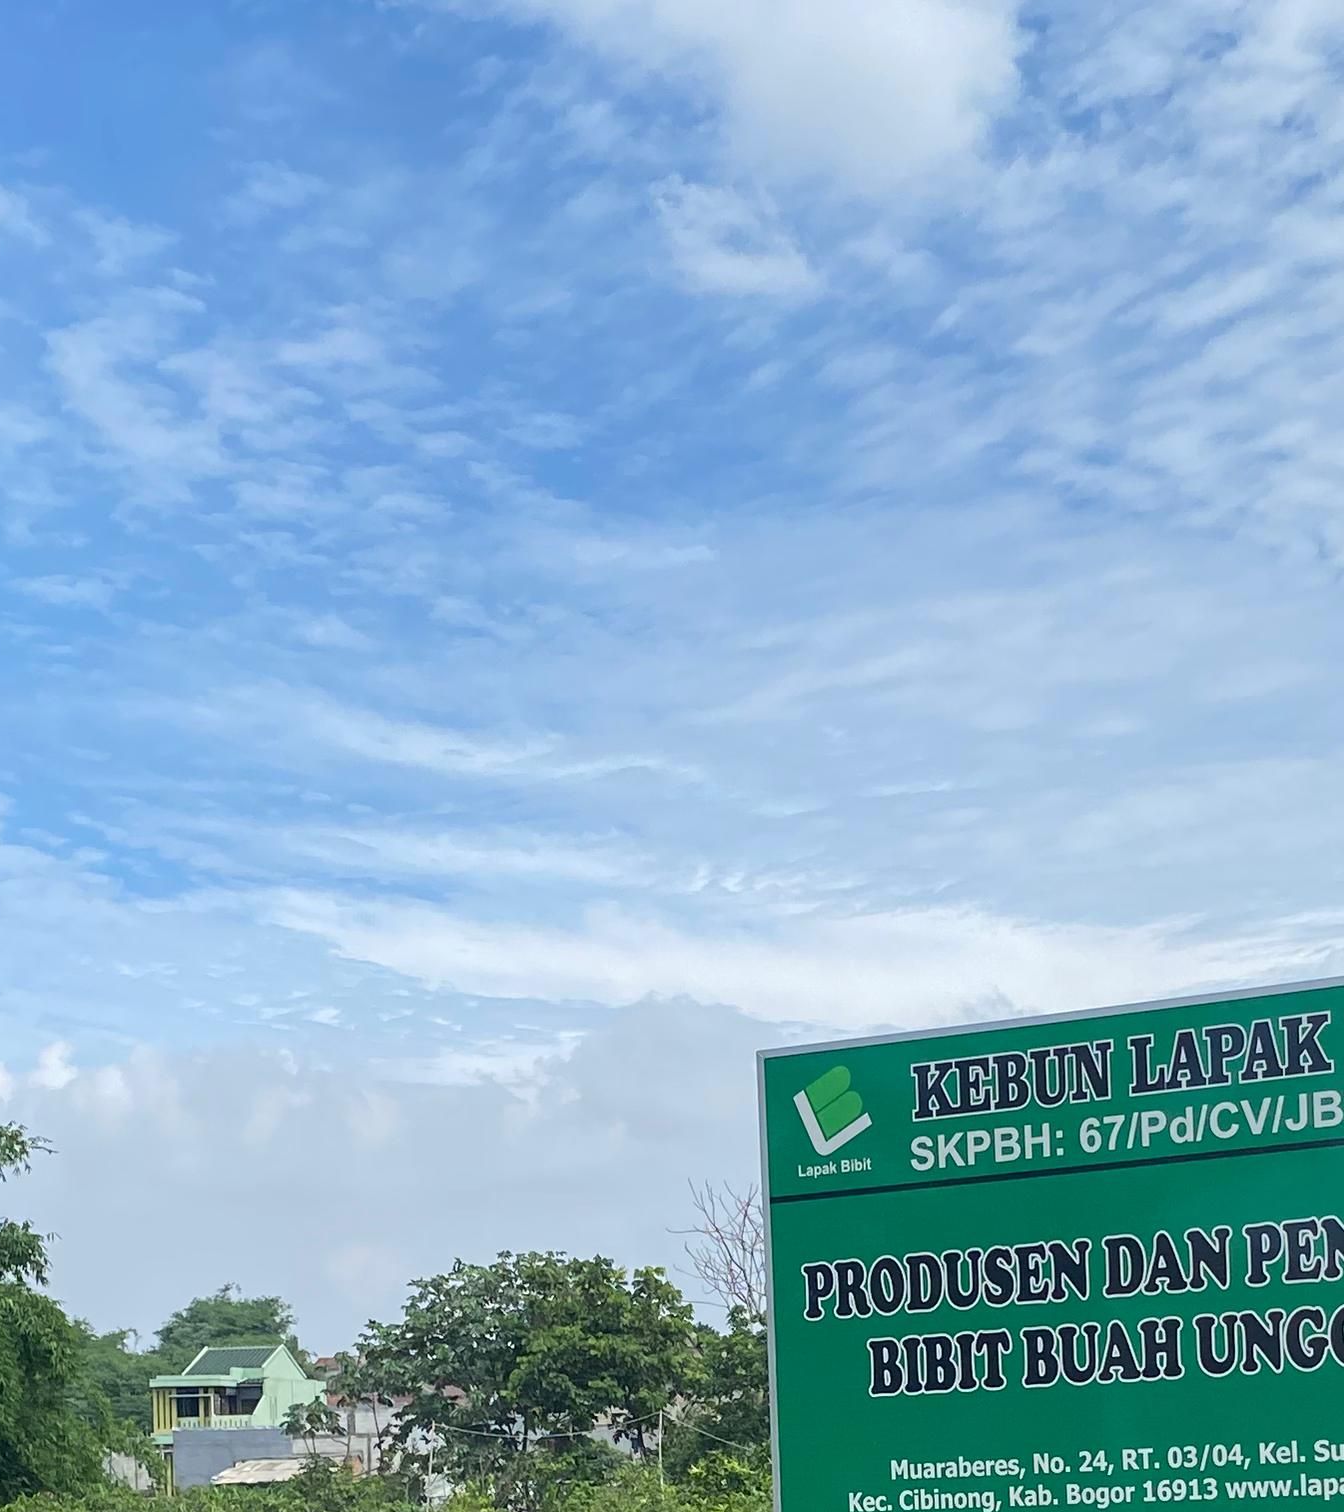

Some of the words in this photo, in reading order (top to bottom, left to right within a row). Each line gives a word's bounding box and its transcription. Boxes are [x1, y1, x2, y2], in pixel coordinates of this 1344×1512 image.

[911, 1039, 1113, 1122] KEBUN
[1128, 1009, 1334, 1097] LAPAK
[798, 1161, 837, 1179] Lapak
[841, 1157, 872, 1173] Bibit
[910, 1122, 1064, 1171] SKPBH:
[801, 1238, 1091, 1321] PRODUSEN
[1102, 1225, 1232, 1298] DAN
[867, 1328, 1012, 1397] BIBIT
[1020, 1316, 1185, 1388] BUAH
[890, 1456, 1026, 1480] Muaraberes,
[1033, 1453, 1071, 1474] No.
[1078, 1450, 1114, 1475] 24,
[1121, 1448, 1160, 1470] RT.
[1167, 1443, 1251, 1471] 03/04,
[1258, 1440, 1306, 1464] Kel.
[848, 1492, 892, 1512] Kec.
[899, 1489, 1002, 1512] Cibinong,
[1009, 1484, 1059, 1507] Kab.
[1066, 1483, 1135, 1509] Bogor
[1143, 1478, 1218, 1502] 16913
